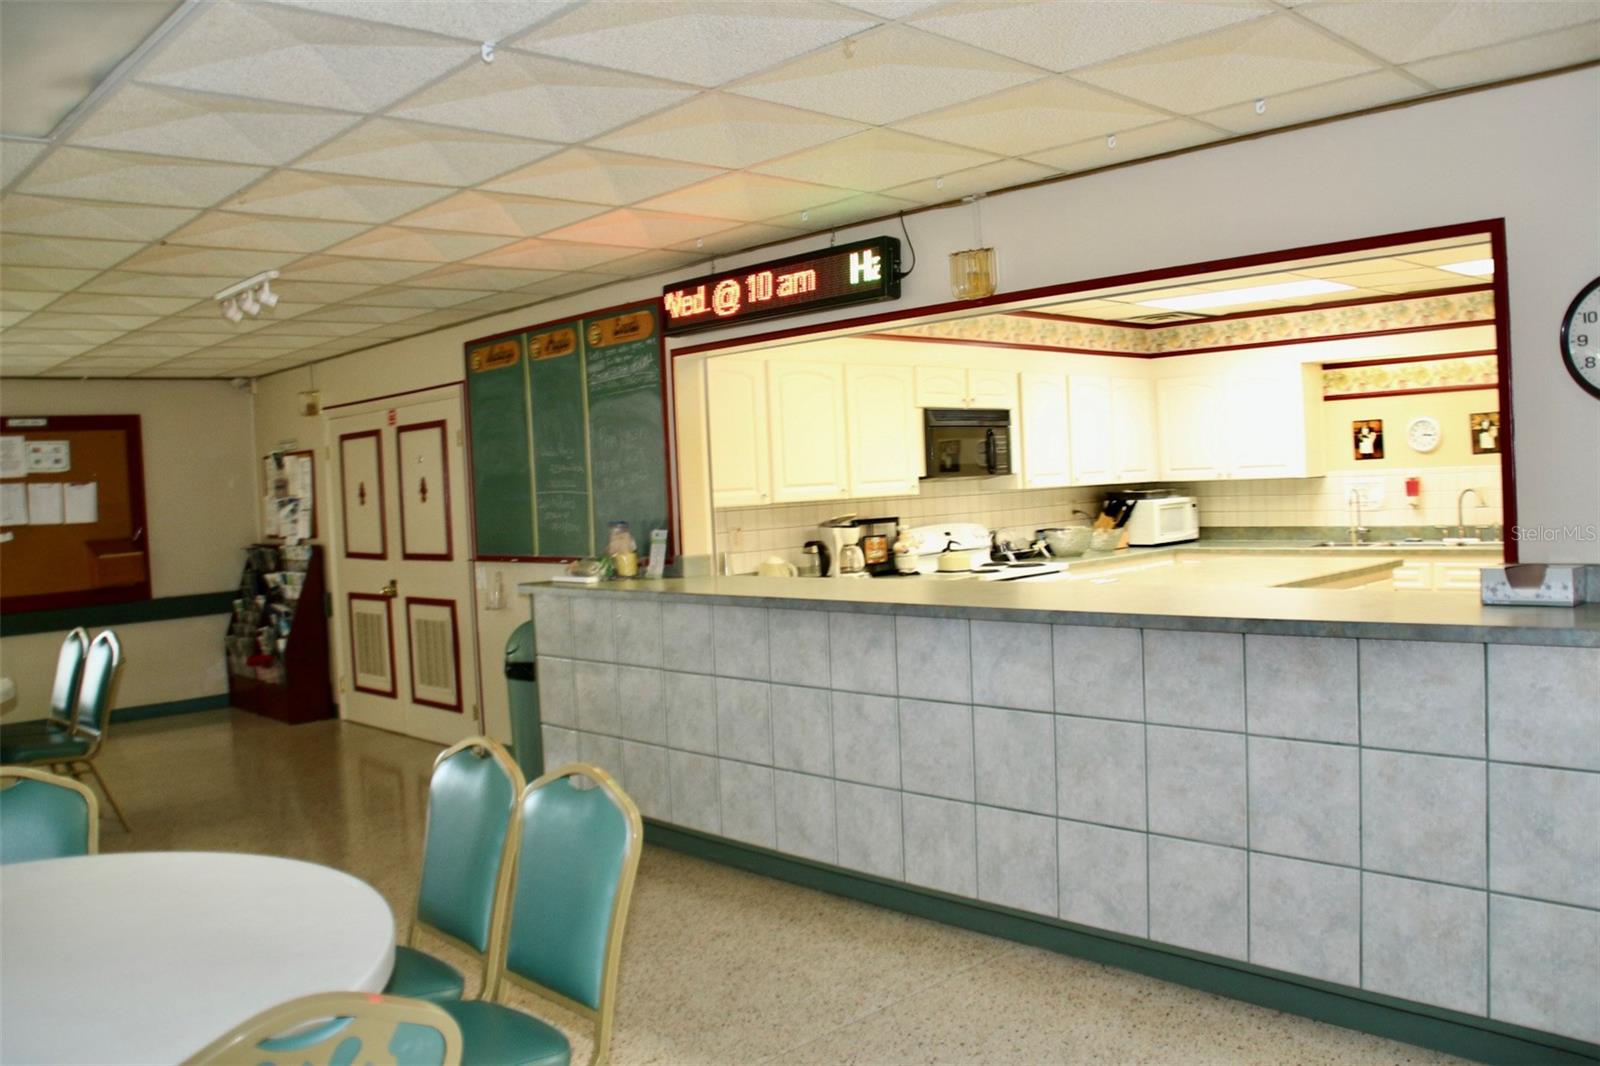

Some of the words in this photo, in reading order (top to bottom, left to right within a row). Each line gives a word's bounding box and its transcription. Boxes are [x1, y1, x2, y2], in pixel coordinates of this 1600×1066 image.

[712, 279, 741, 316] @
[746, 270, 773, 303] 10
[776, 269, 817, 297] am
[1583, 311, 1598, 324] 10
[1577, 335, 1588, 347] 9
[1585, 357, 1596, 369] 8
